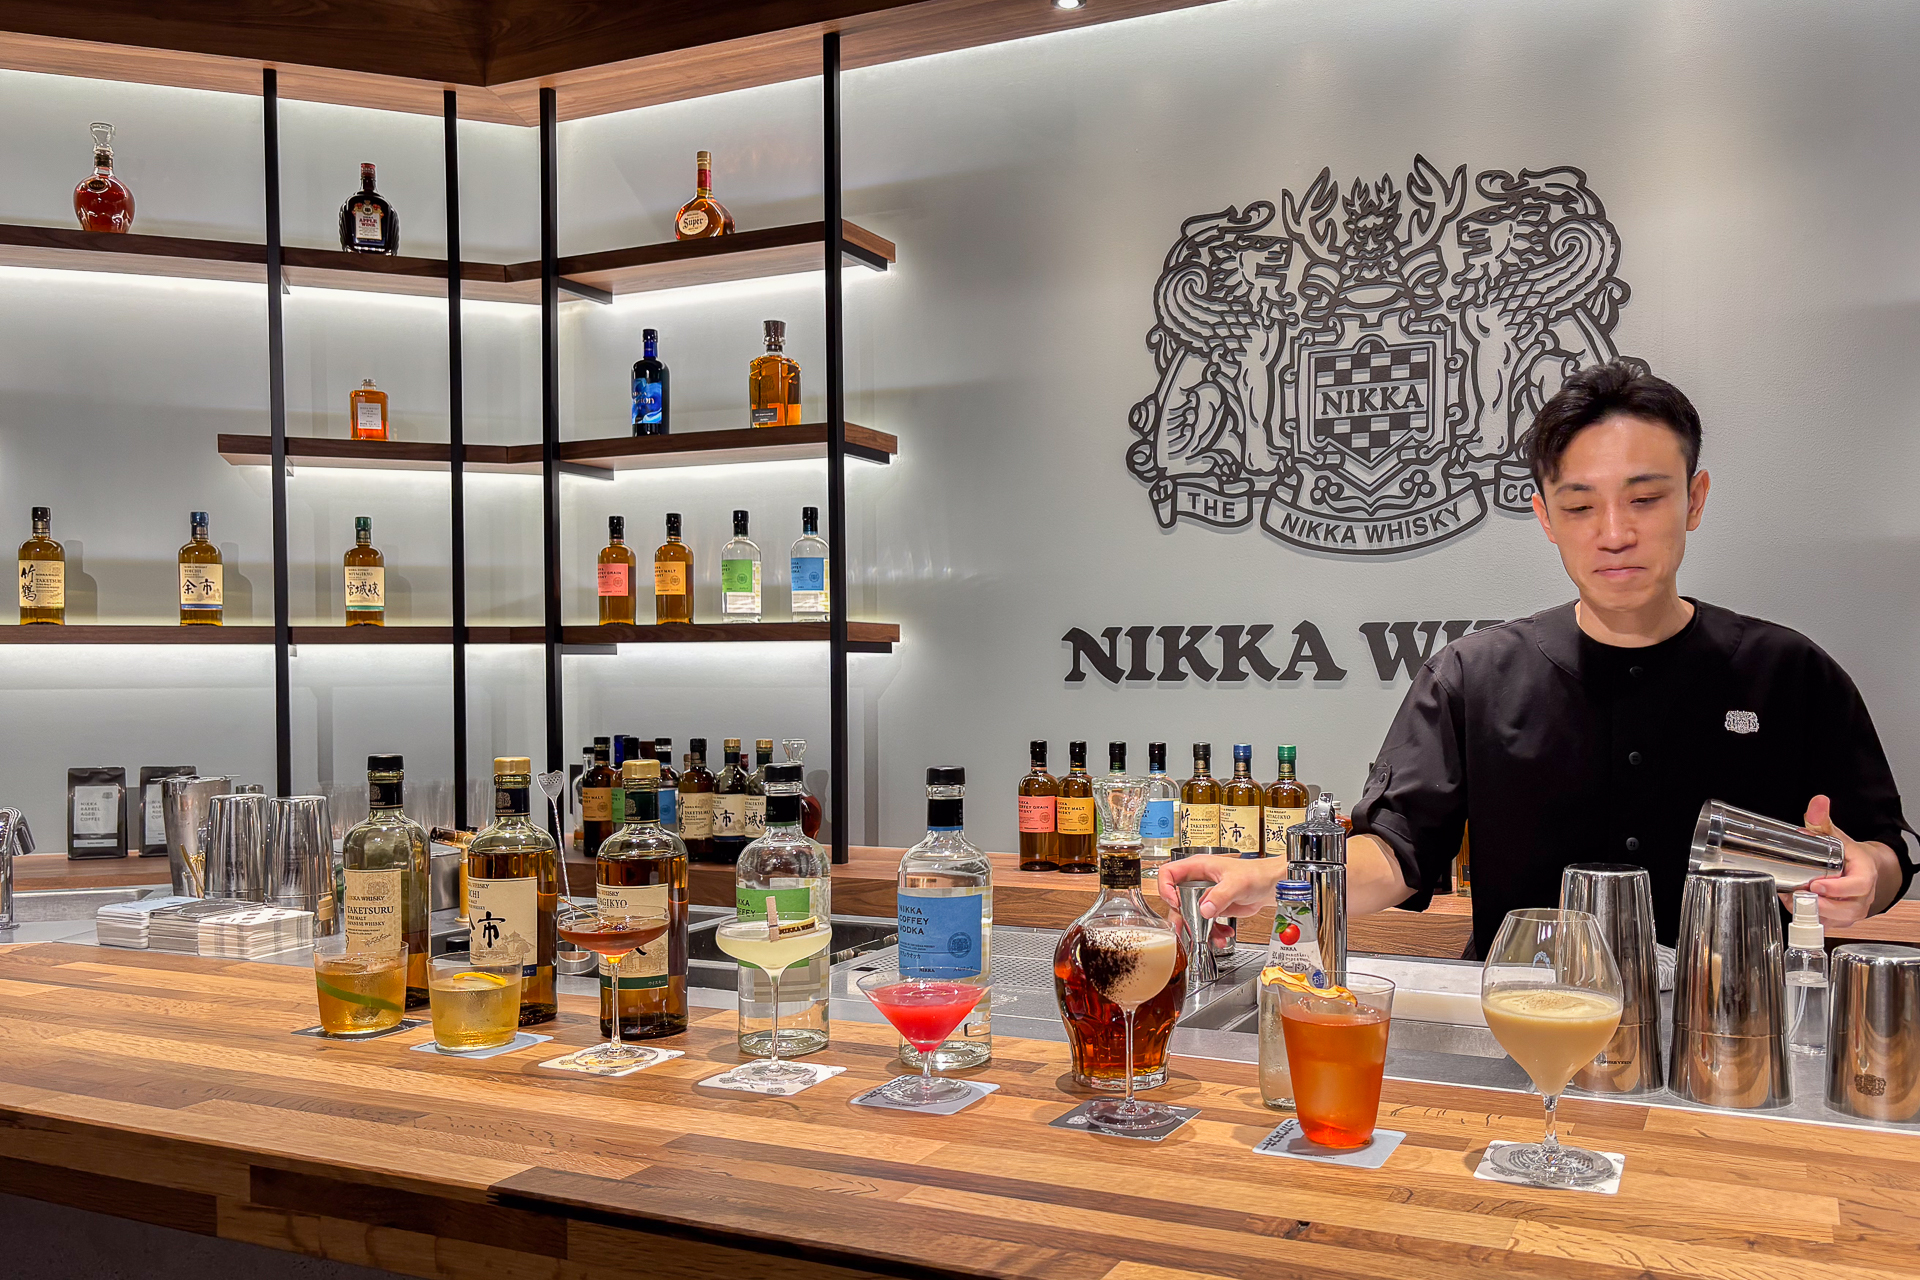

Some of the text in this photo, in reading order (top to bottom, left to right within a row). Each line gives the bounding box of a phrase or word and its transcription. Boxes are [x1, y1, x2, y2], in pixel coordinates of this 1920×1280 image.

[682, 217, 704, 229] Super
[1321, 384, 1425, 416] NIKKA
[1187, 492, 1235, 519] THE
[1280, 512, 1357, 544] NIKKA
[1364, 502, 1461, 544] WHISKY
[182, 578, 215, 596] 余市
[1061, 620, 1348, 684] NIKKA
[1265, 825, 1287, 845] 宮城
[347, 906, 394, 915] TAKETSURU
[899, 905, 923, 915] NIKKA
[899, 914, 930, 925] COFFEY
